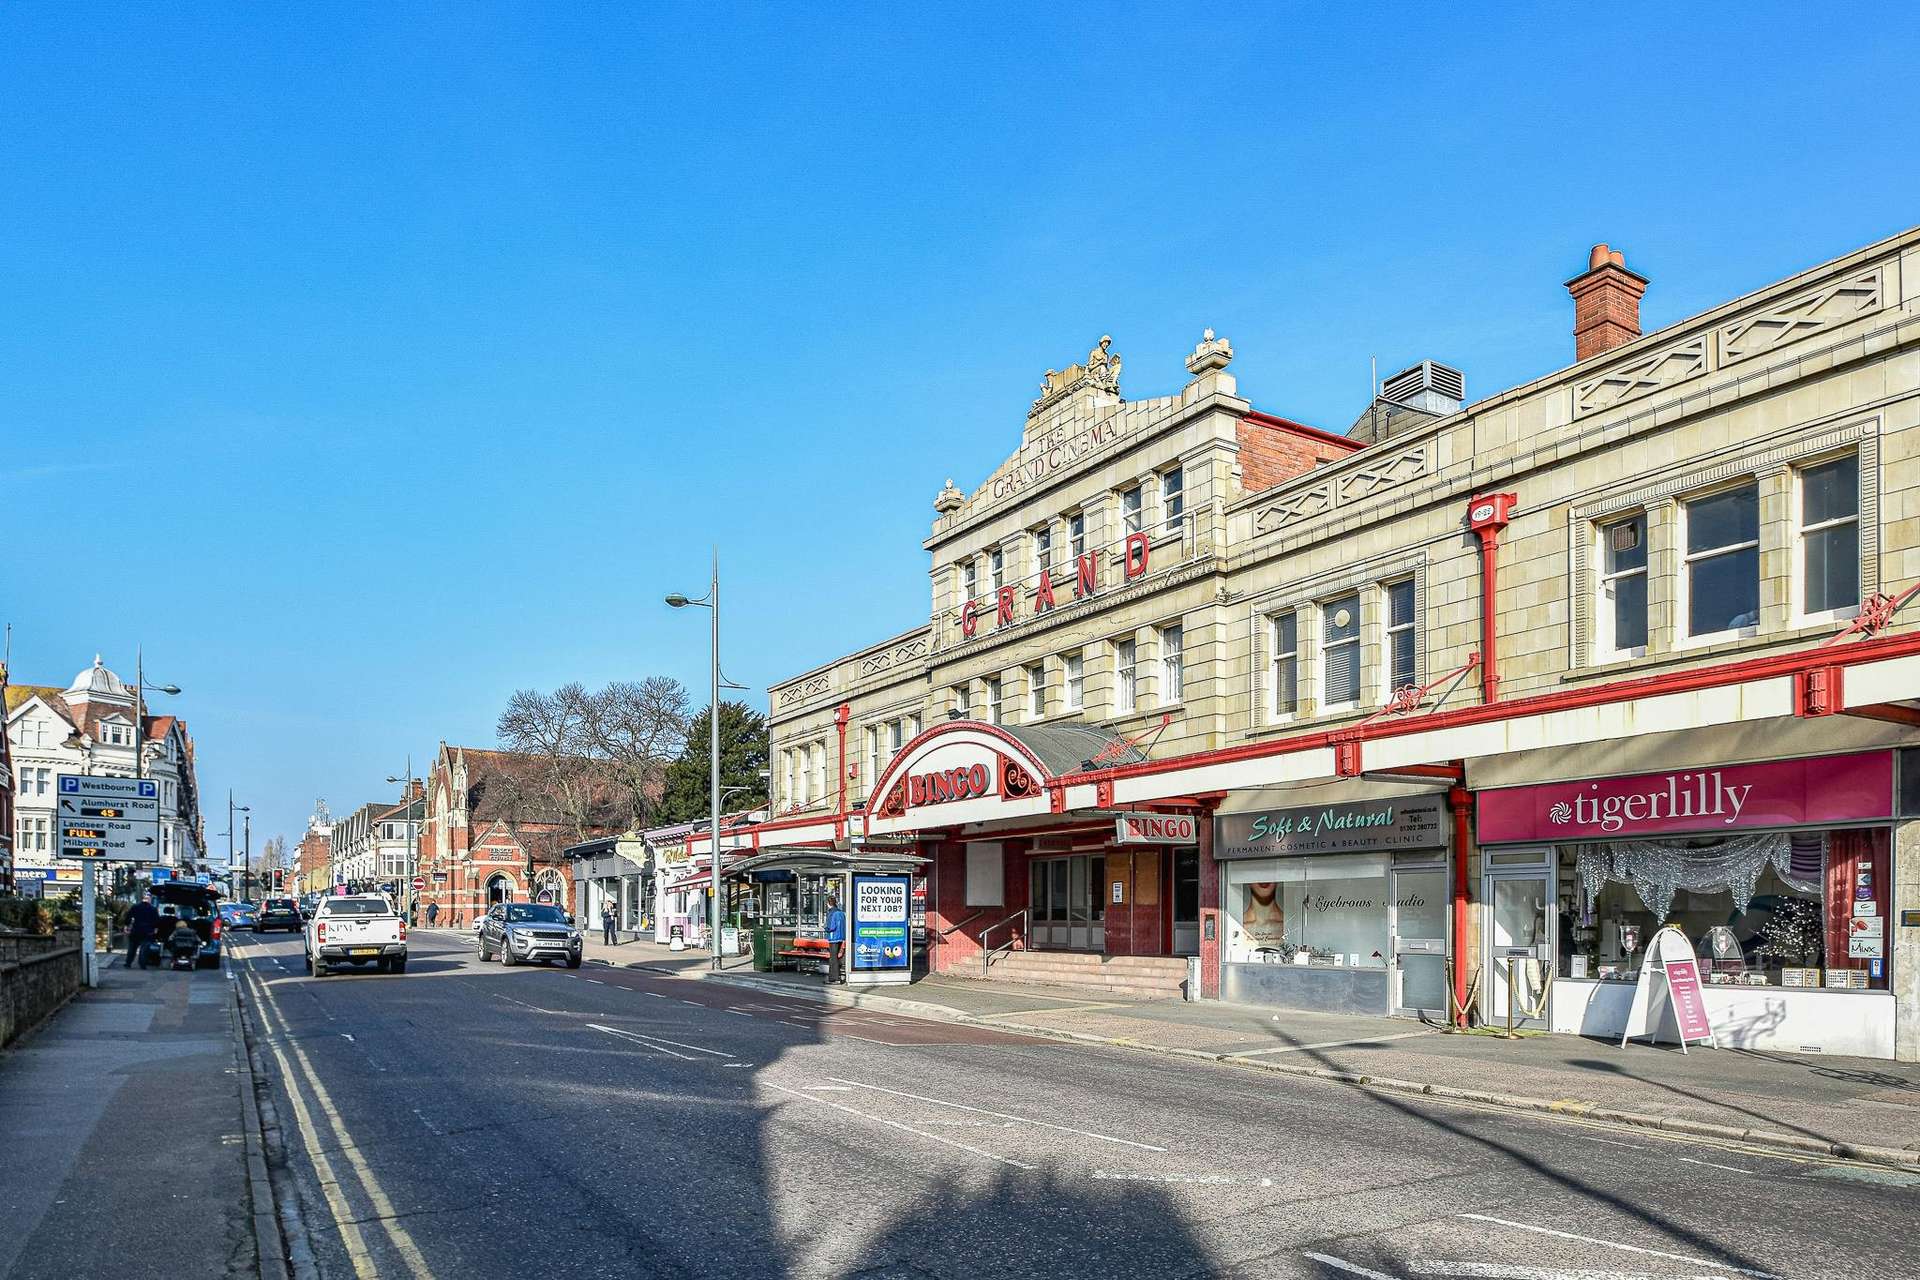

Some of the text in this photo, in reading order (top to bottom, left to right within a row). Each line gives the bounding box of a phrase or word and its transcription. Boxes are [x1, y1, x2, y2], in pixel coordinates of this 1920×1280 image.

[1039, 427, 1066, 453] THE
[993, 420, 1117, 499] GRAND CINEMA
[961, 531, 1150, 637] GRAND
[82, 781, 137, 792] Westbourne
[910, 763, 990, 806] BINGO
[81, 799, 155, 810] Alumhurst Road
[1574, 771, 1753, 832] tigerlilly
[100, 809, 116, 818] 45
[63, 821, 131, 830] Landseer Road
[68, 829, 97, 838] FULL
[1127, 817, 1193, 839] BINGO
[1248, 806, 1394, 843] Soft & Natural
[63, 839, 126, 849] Milburn Road
[1227, 845, 1277, 854] PERMANENT
[1280, 841, 1327, 851] COSMETIC
[1342, 838, 1378, 848] BEAUTY
[1384, 834, 1424, 844] CLINIC
[860, 886, 903, 895] LOOKING
[860, 896, 903, 904] FOR YOUR
[1315, 894, 1373, 912] Eyebrows
